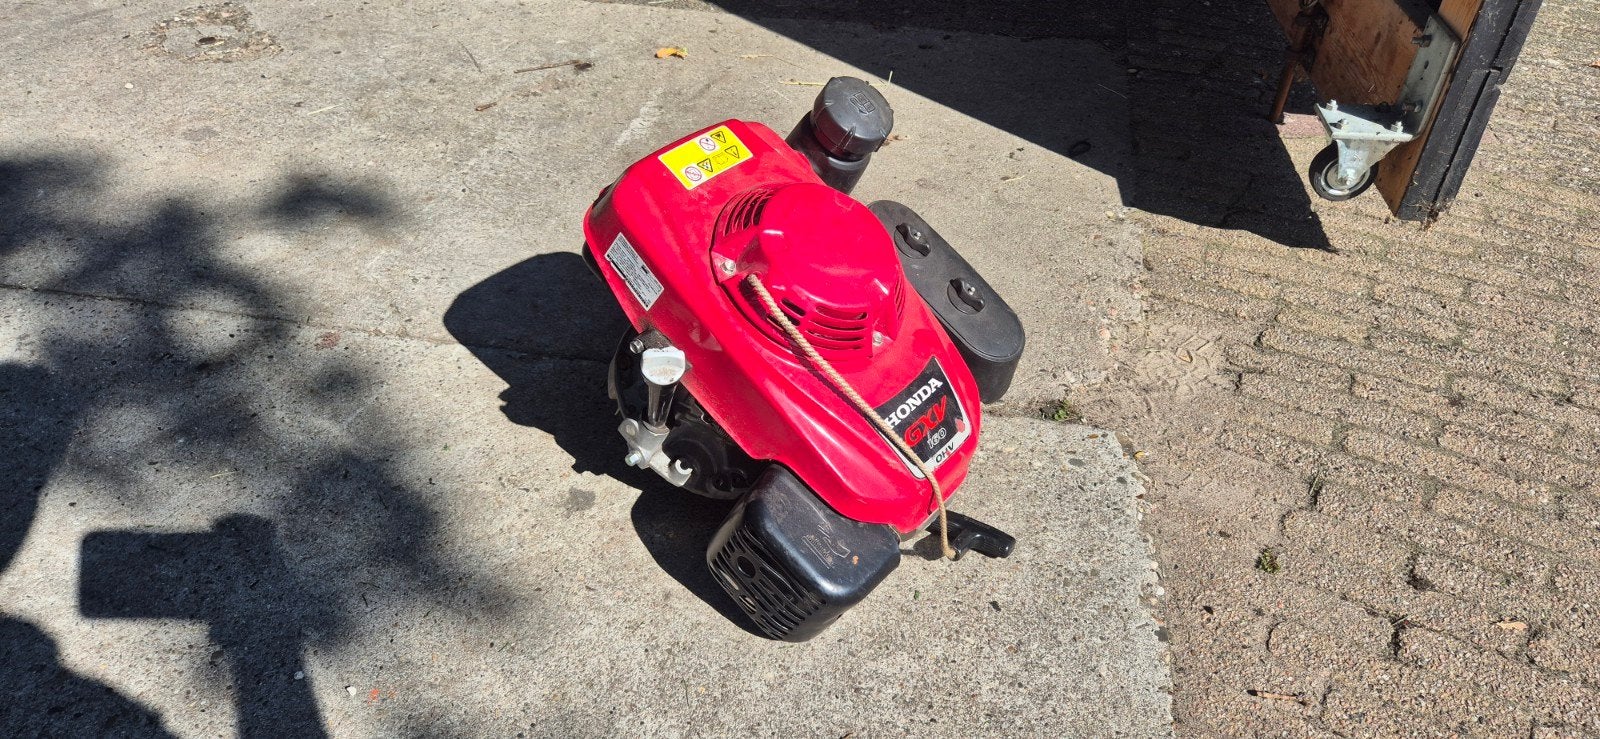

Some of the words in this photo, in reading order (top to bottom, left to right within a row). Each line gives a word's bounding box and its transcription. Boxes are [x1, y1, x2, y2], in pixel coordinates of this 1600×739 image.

[884, 377, 943, 429] HONDA
[904, 395, 947, 447] GXV
[927, 427, 947, 449] 160
[935, 442, 955, 463] OHV
